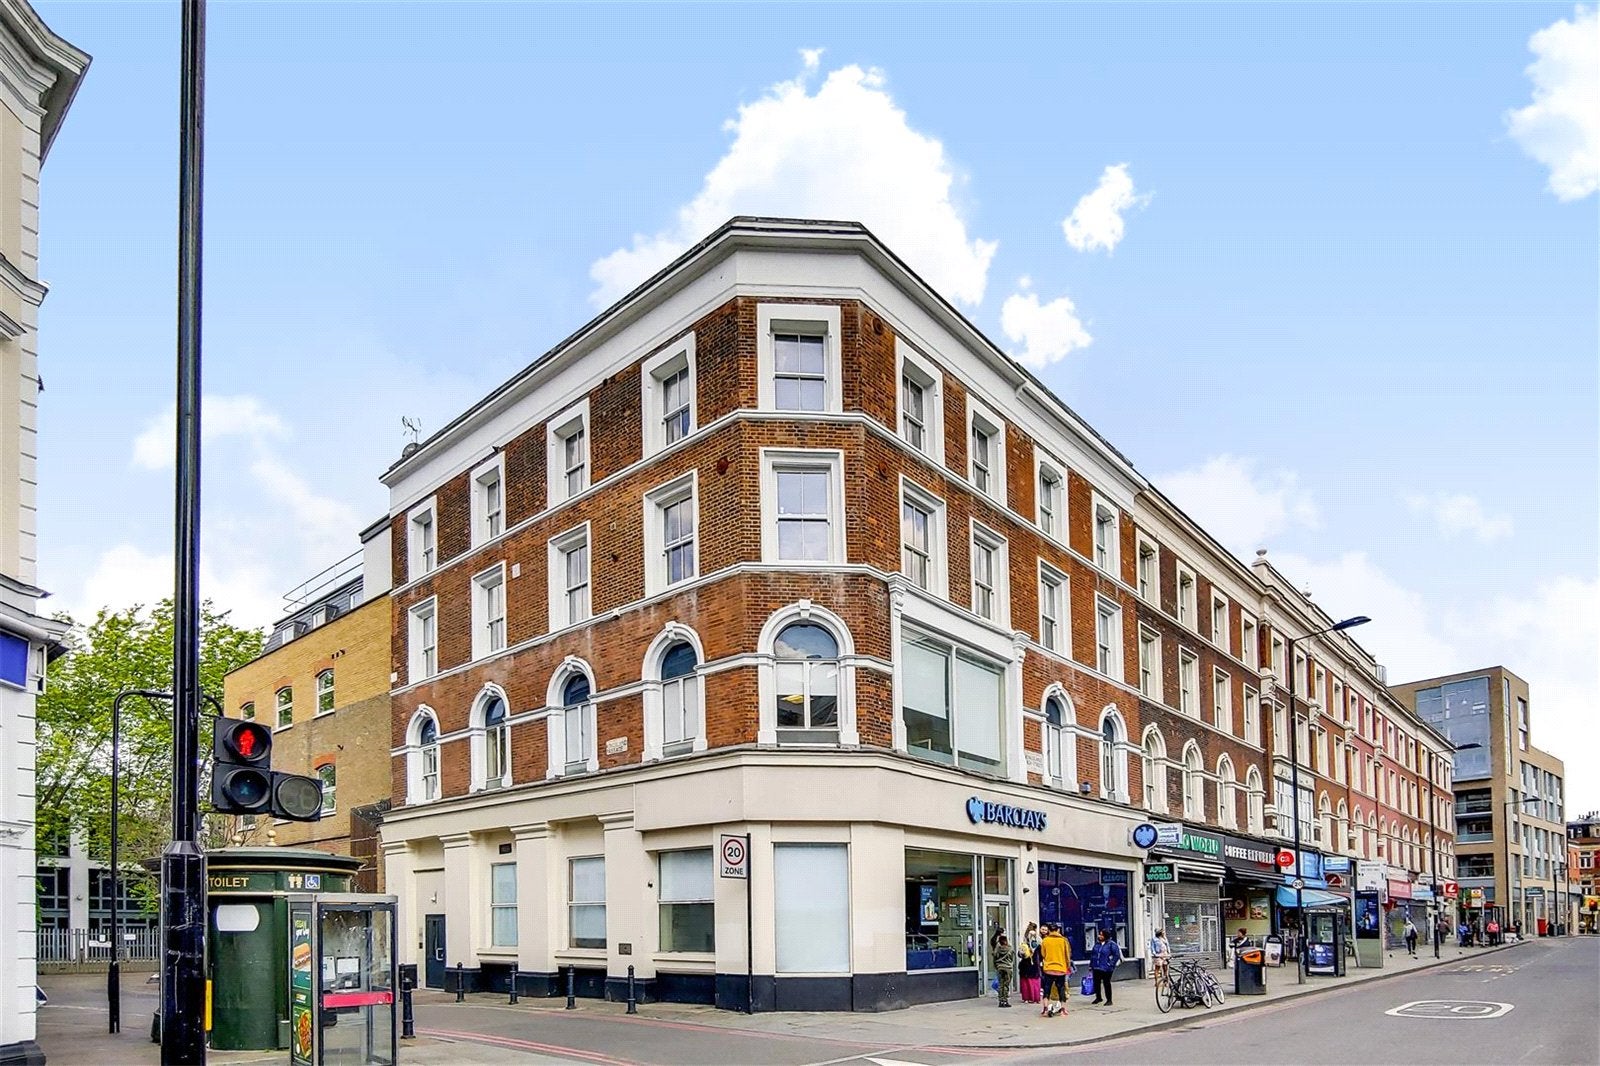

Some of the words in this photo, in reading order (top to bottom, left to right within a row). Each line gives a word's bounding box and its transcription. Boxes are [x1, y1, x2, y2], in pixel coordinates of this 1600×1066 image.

[982, 802, 1047, 830] BARCLAYS
[727, 847, 740, 857] 20
[1224, 845, 1247, 859] COFFEE
[725, 867, 743, 875] ZONE
[1146, 872, 1173, 881] WORLD
[209, 877, 249, 887] TOILET
